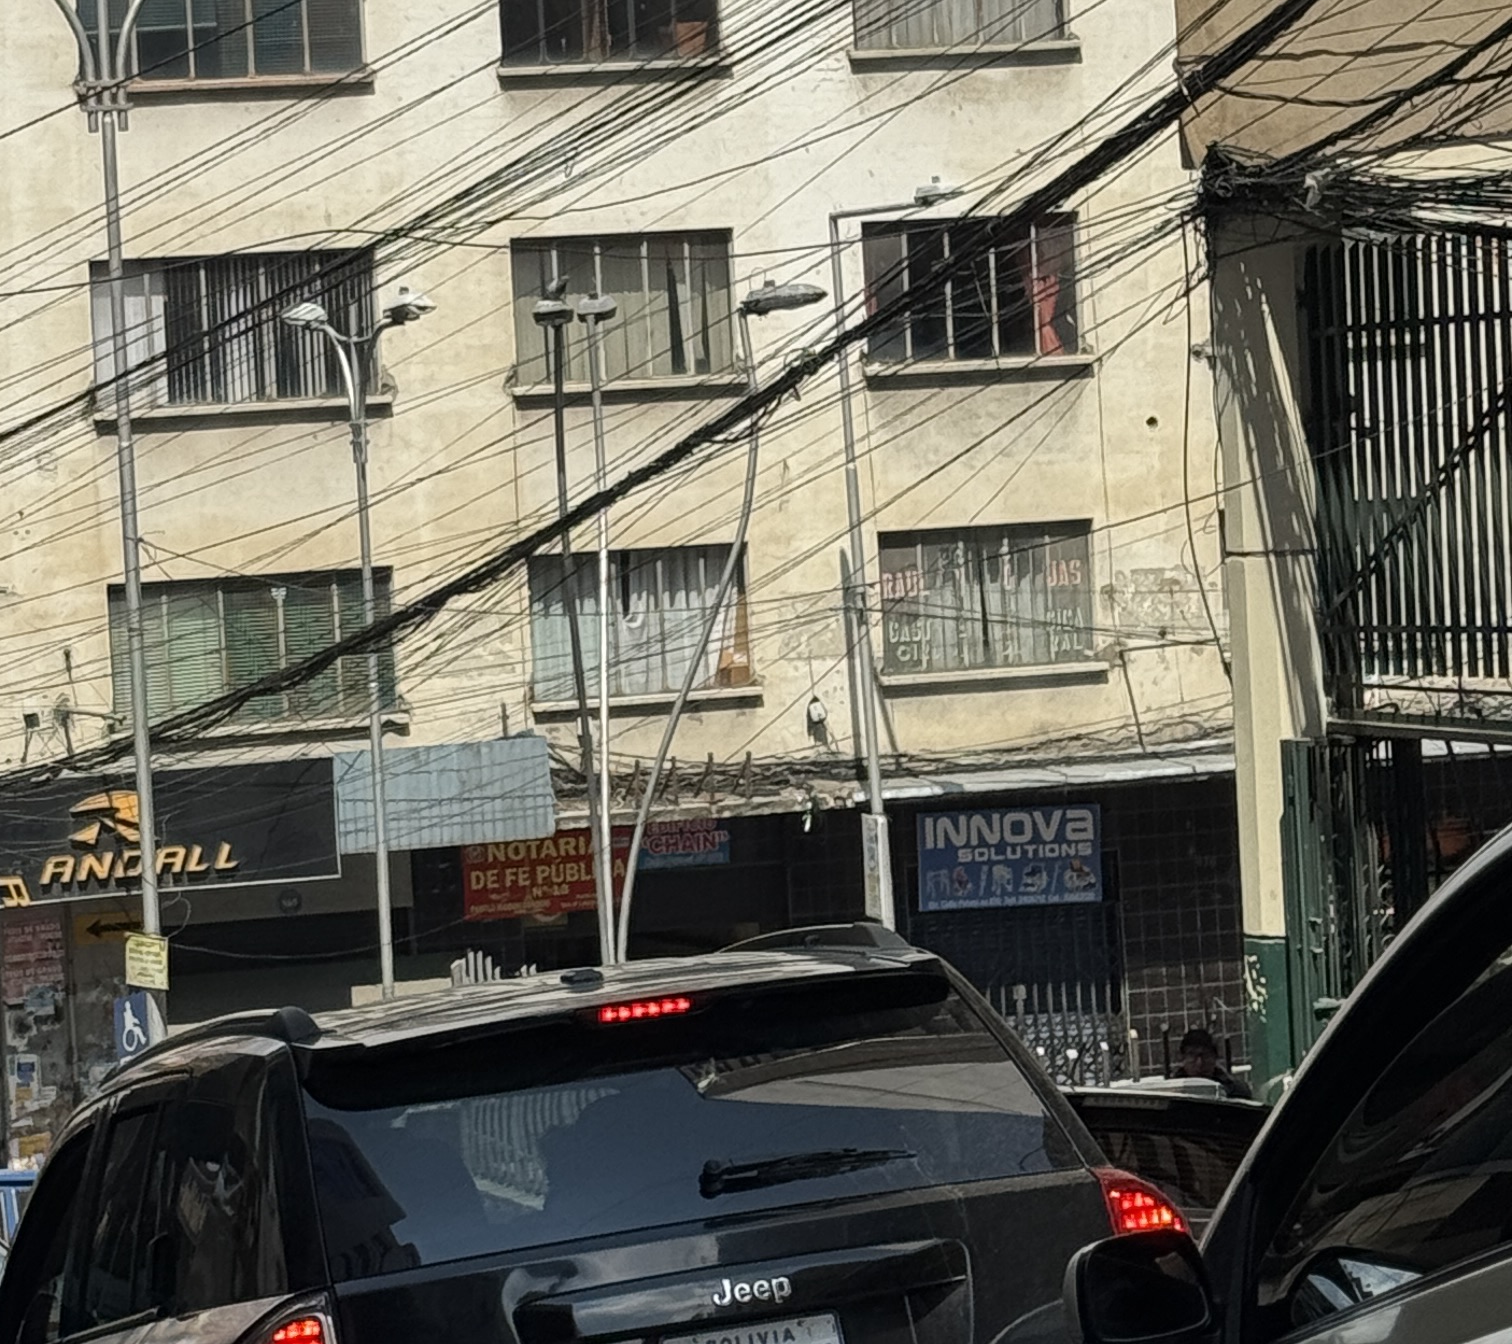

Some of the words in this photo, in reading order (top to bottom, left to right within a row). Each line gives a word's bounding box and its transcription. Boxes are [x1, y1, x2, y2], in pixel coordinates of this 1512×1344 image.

[957, 842, 1092, 863] SOLUTIONS
[470, 869, 499, 891] DE
[505, 865, 531, 887] FE
[712, 1276, 792, 1307] Jeep
